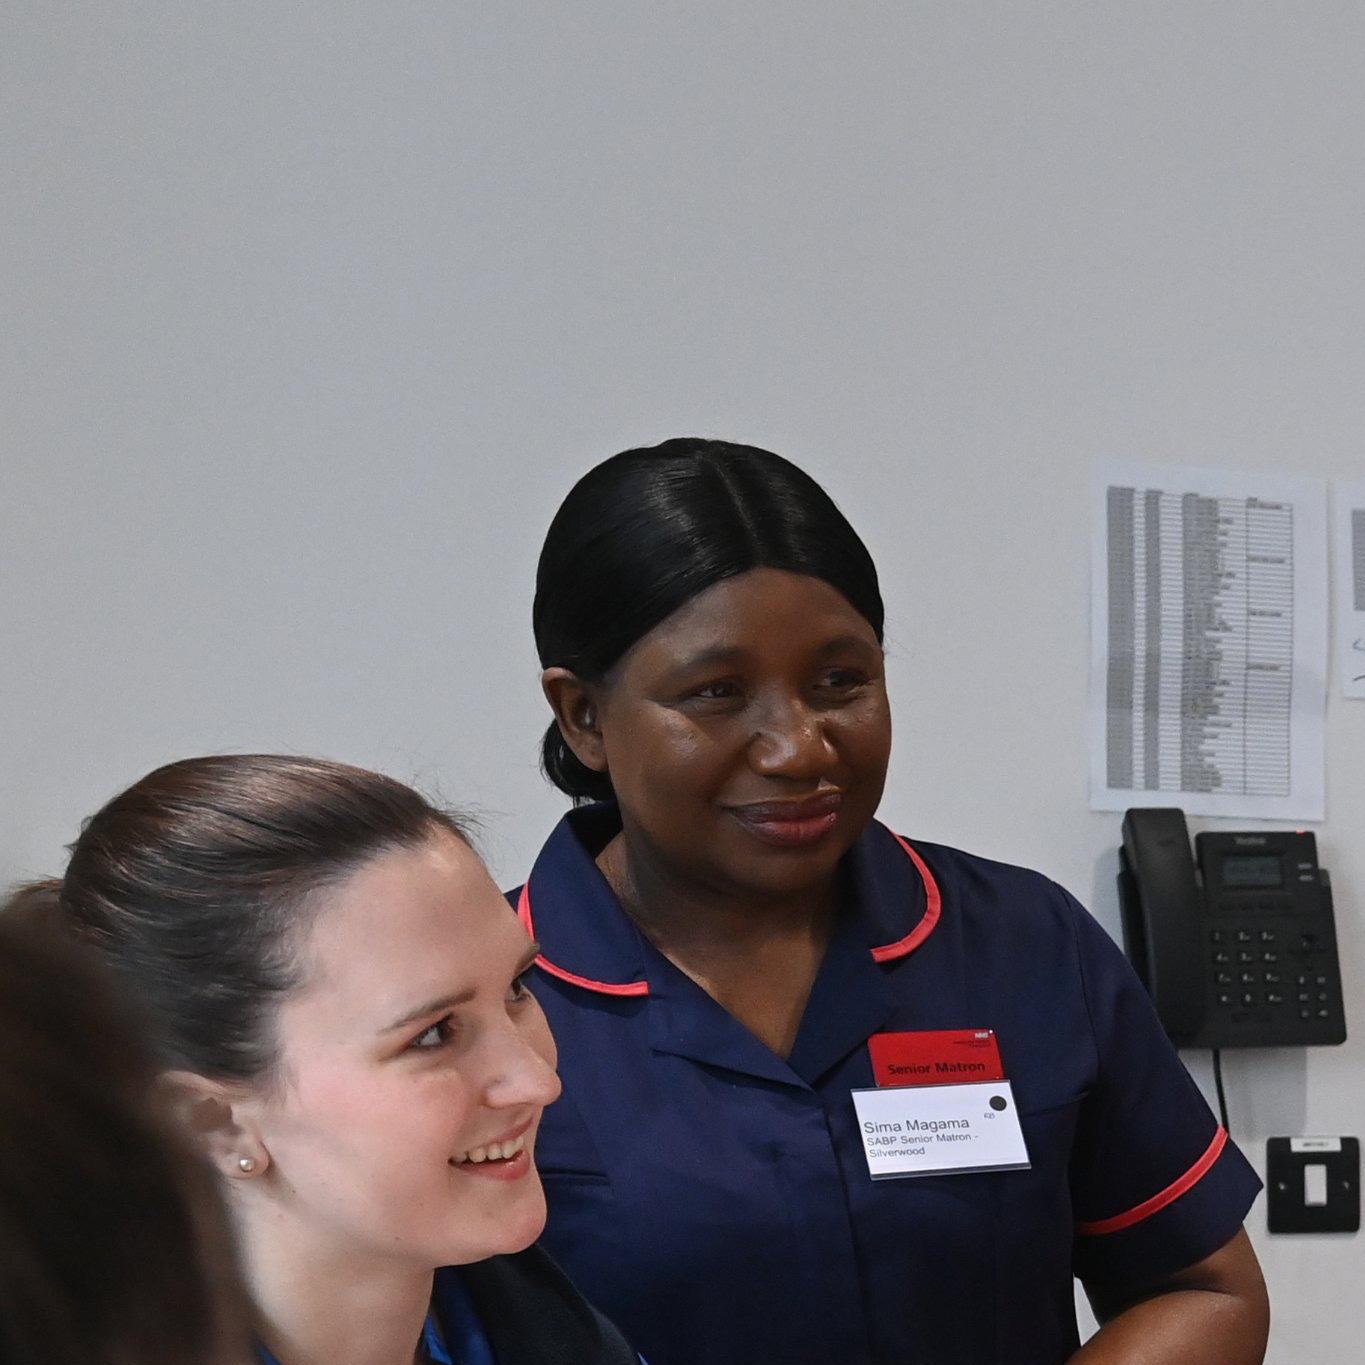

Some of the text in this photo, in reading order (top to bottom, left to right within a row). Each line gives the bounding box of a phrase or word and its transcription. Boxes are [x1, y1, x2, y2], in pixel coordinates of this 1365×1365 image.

[888, 1062, 986, 1075] Senior Matron
[864, 1118, 970, 1134] Sima Magama
[867, 1136, 898, 1146] SABP
[900, 1134, 934, 1145] Senior
[936, 1132, 972, 1142] Matron
[869, 1146, 926, 1158] Silverwood
